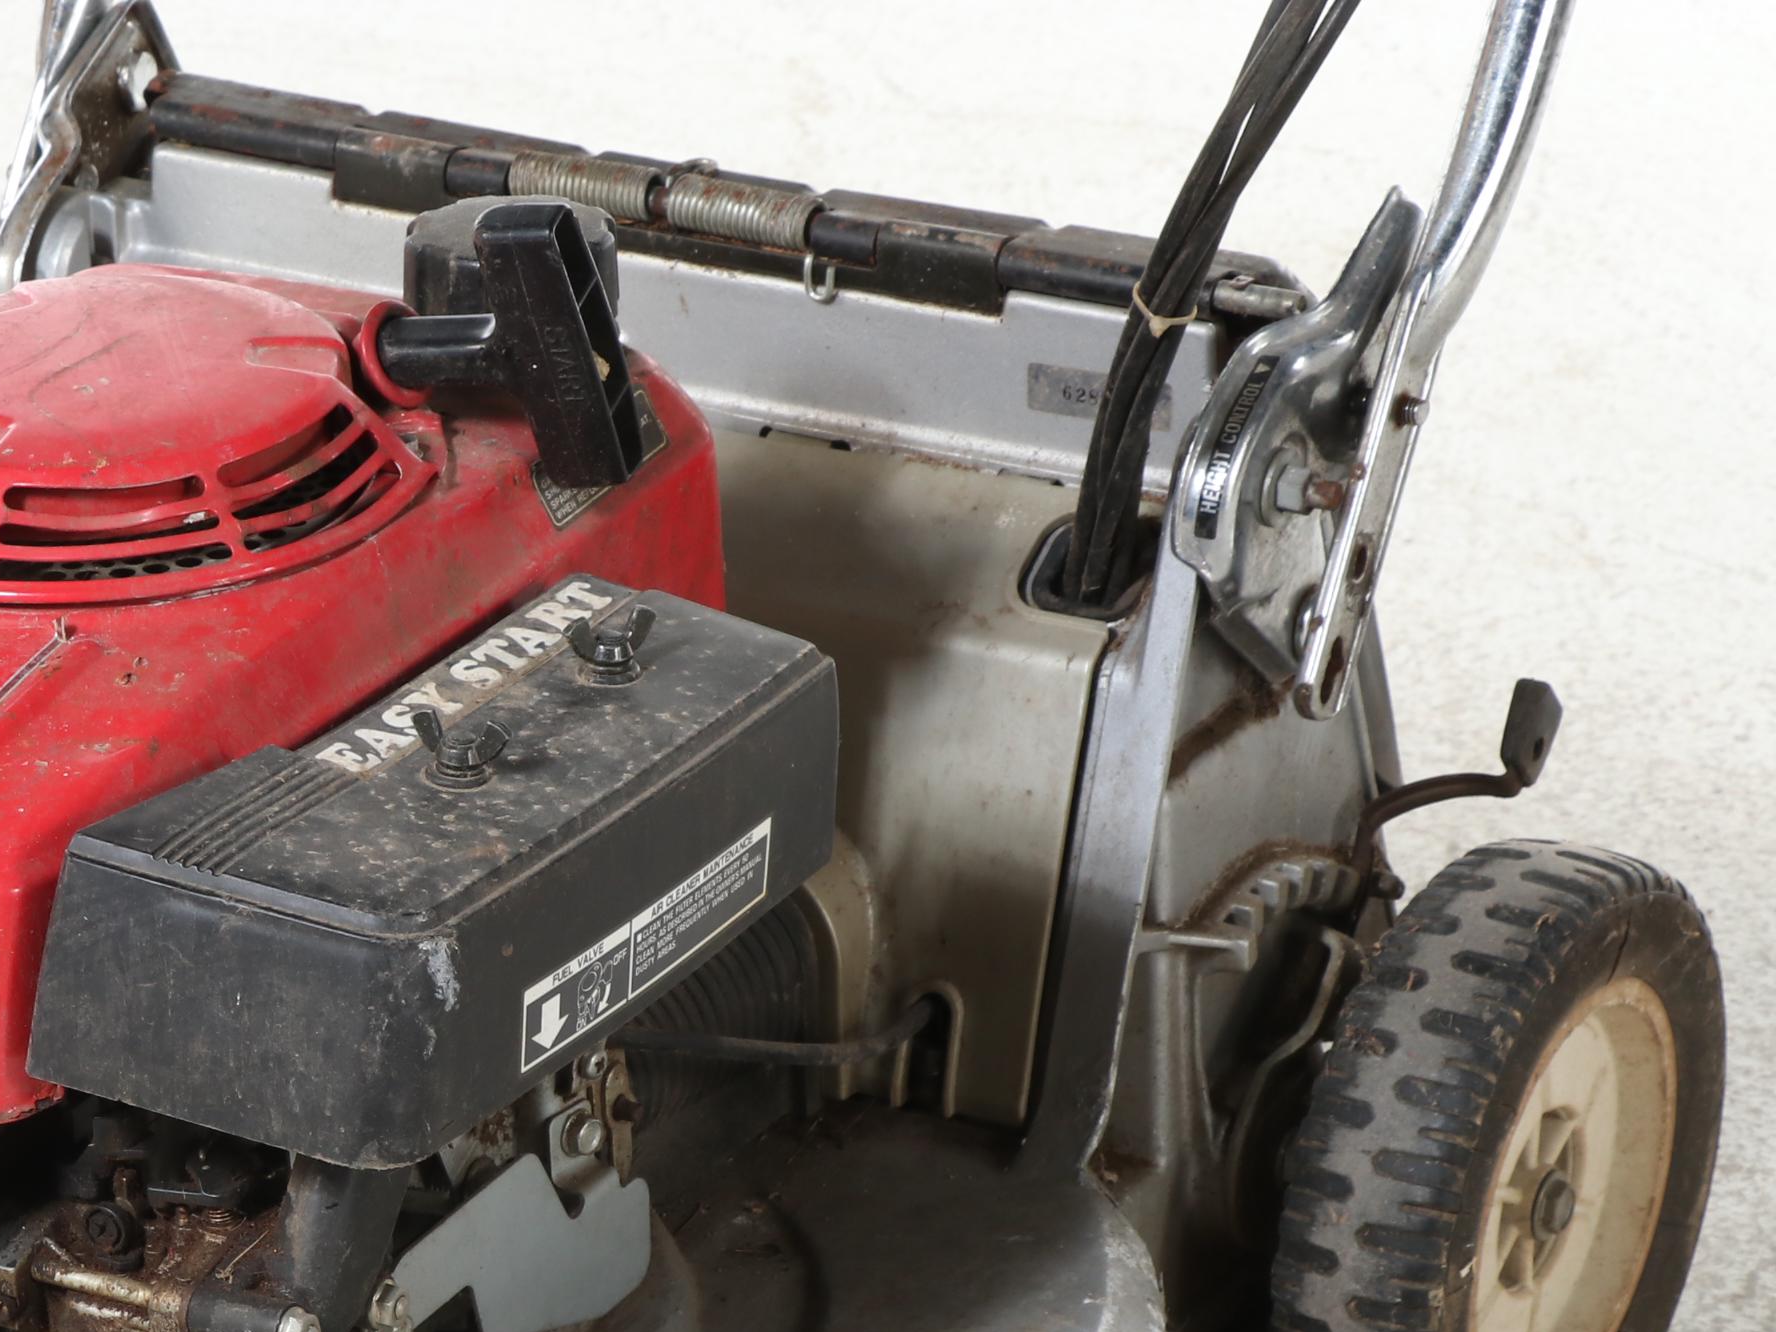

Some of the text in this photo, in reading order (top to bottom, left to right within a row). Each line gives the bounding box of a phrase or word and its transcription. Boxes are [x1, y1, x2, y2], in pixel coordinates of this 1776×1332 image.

[1199, 381, 1265, 515] HEIGHT CONTROL
[314, 580, 613, 773] EASY START
[642, 920, 662, 939] CLEAN
[663, 909, 674, 925] THE
[675, 896, 693, 914] FILTER
[694, 873, 722, 901] ELEMENTS
[724, 861, 741, 878] EVERY
[658, 926, 667, 938] AS
[667, 903, 698, 931] DESCRIBED
[705, 889, 715, 902] THE
[740, 853, 762, 875] MANUAL
[665, 873, 701, 906] CLEANER
[702, 832, 754, 880] MAINTENANCE
[635, 870, 754, 965] CLEAN MORE FREQUENTLY WHEN USED IN
[551, 942, 606, 986] FUEL VALVE
[612, 947, 628, 966] OFF
[635, 957, 655, 976] DUSTY
[576, 1016, 588, 1032] ON
